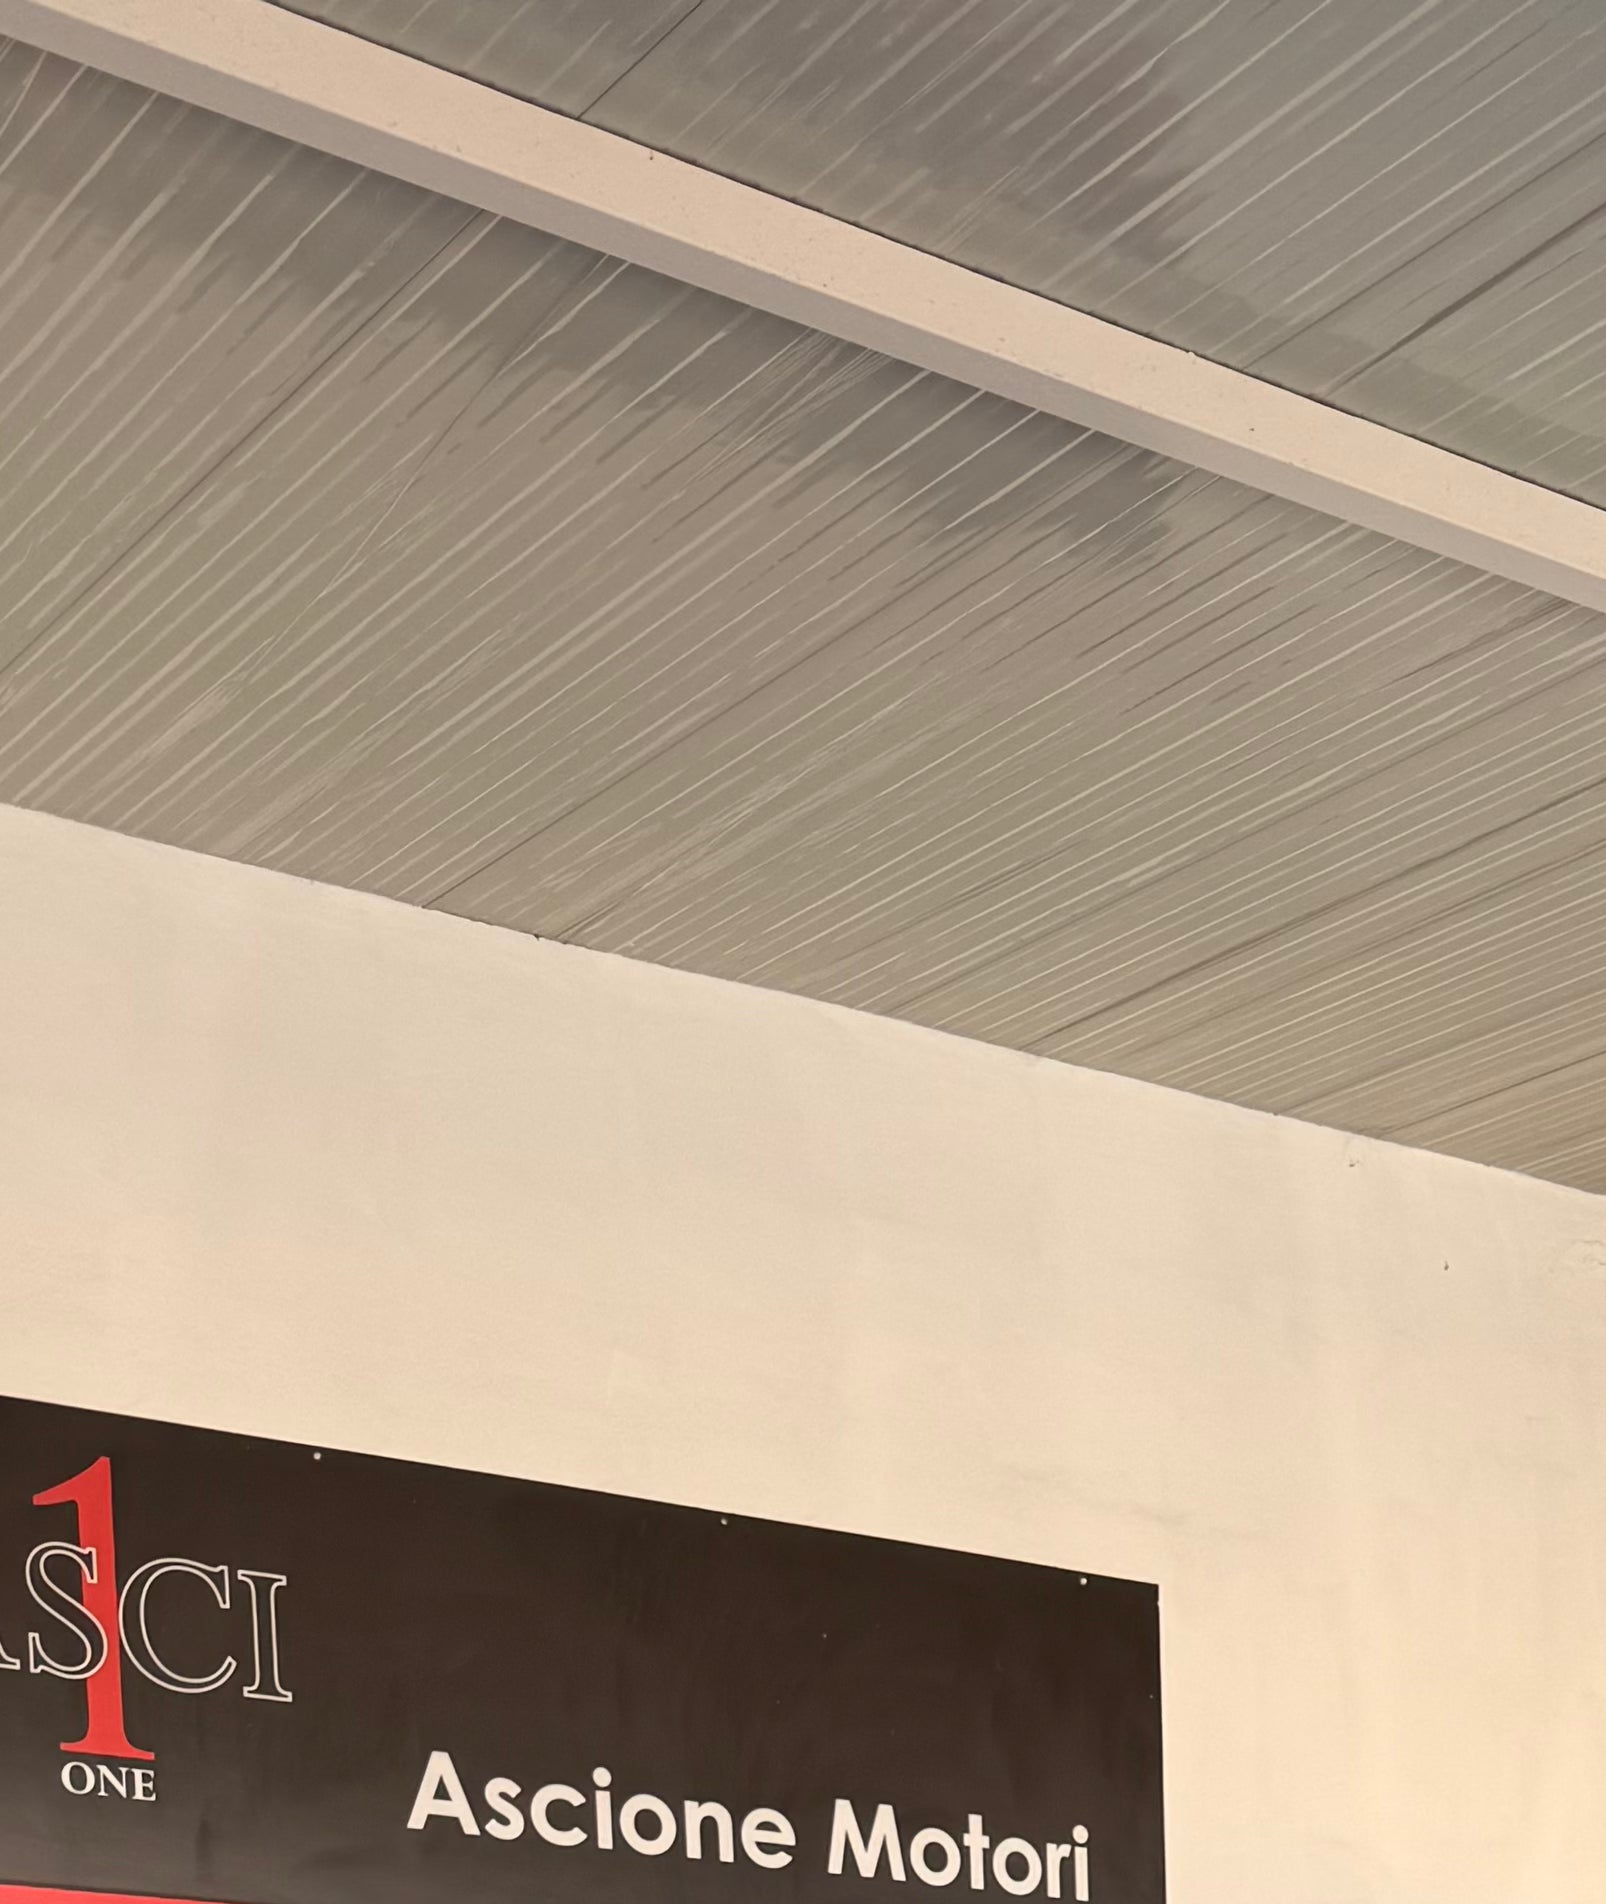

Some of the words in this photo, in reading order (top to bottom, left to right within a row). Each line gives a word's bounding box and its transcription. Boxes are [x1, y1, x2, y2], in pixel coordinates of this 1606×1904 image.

[0, 1541, 293, 1702] SCI
[60, 1761, 156, 1801] ONE
[406, 1750, 797, 1869] Ascione
[827, 1798, 1089, 1902] Motori
